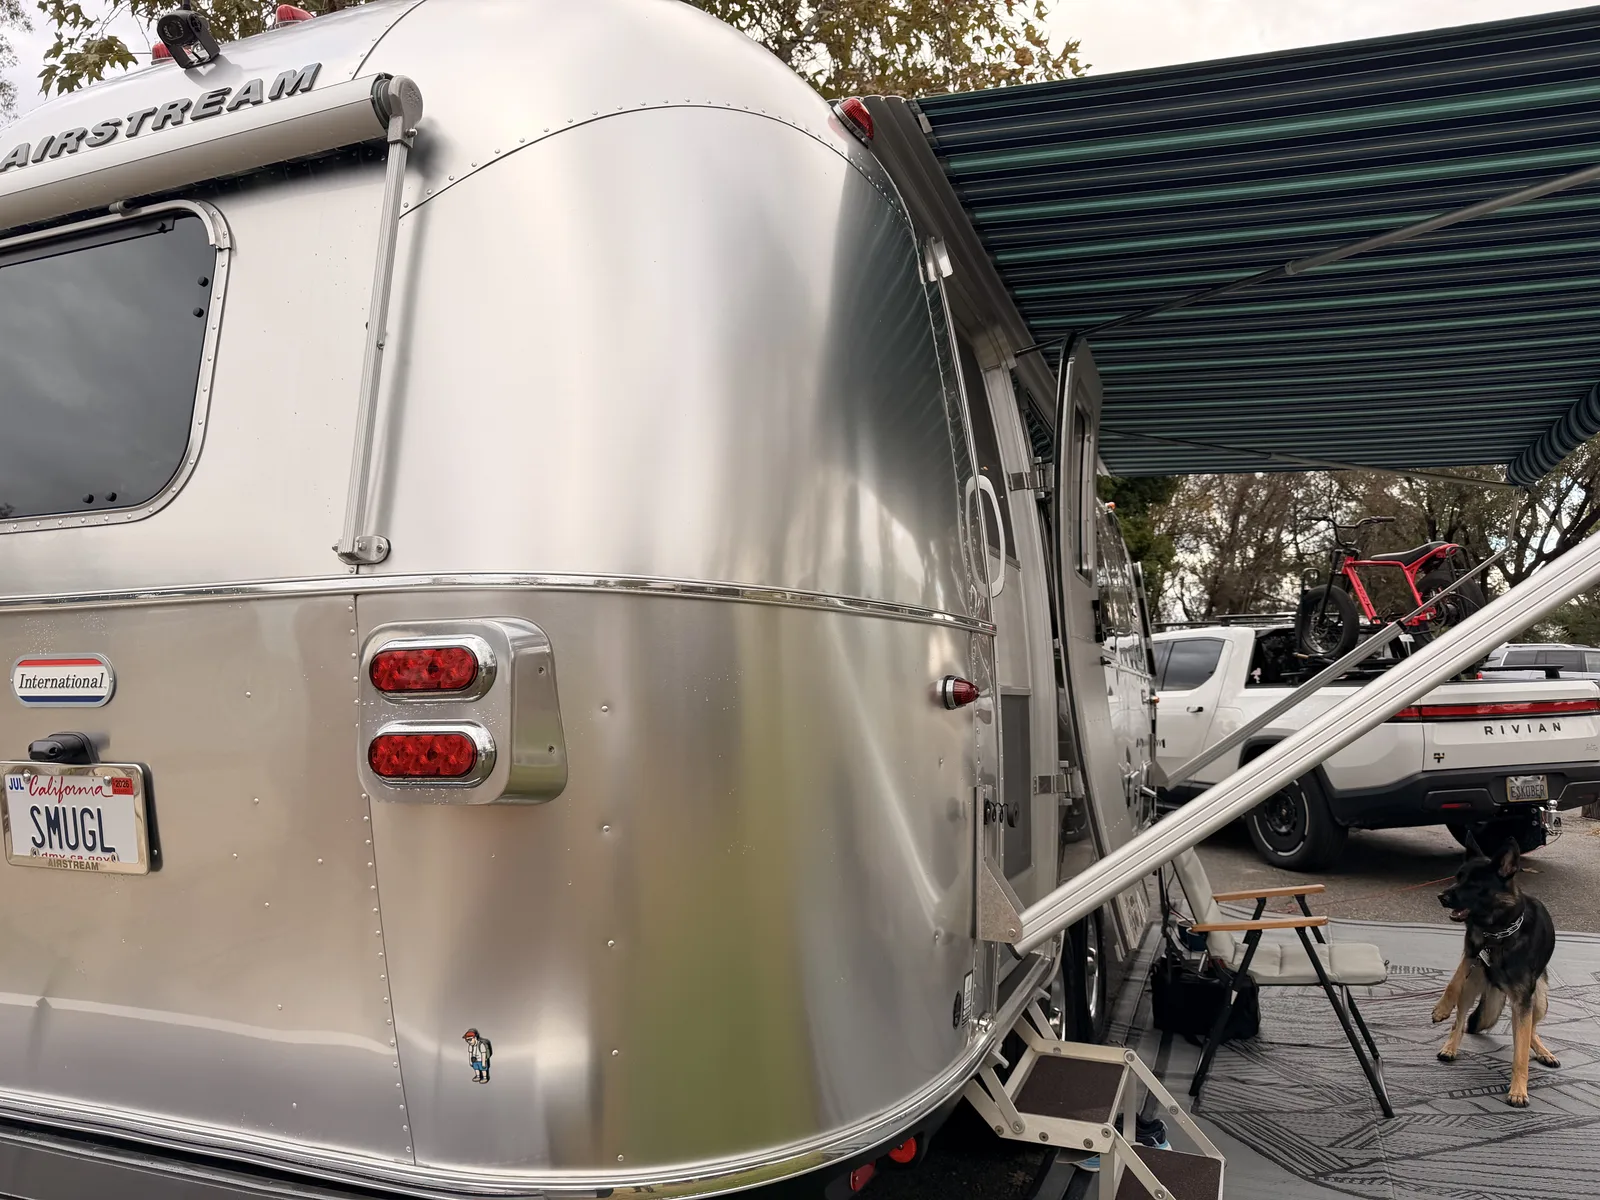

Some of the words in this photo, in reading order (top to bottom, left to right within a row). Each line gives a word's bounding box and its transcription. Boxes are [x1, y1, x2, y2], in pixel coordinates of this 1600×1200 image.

[0, 62, 323, 172] AIRSTREAM
[18, 673, 105, 690] International
[1484, 722, 1562, 735] RIVIAN
[9, 777, 25, 791] JUL
[29, 775, 114, 804] California
[114, 779, 130, 789] 2026
[29, 805, 116, 853] SMUGL
[48, 858, 99, 871] AIRSTREAM
